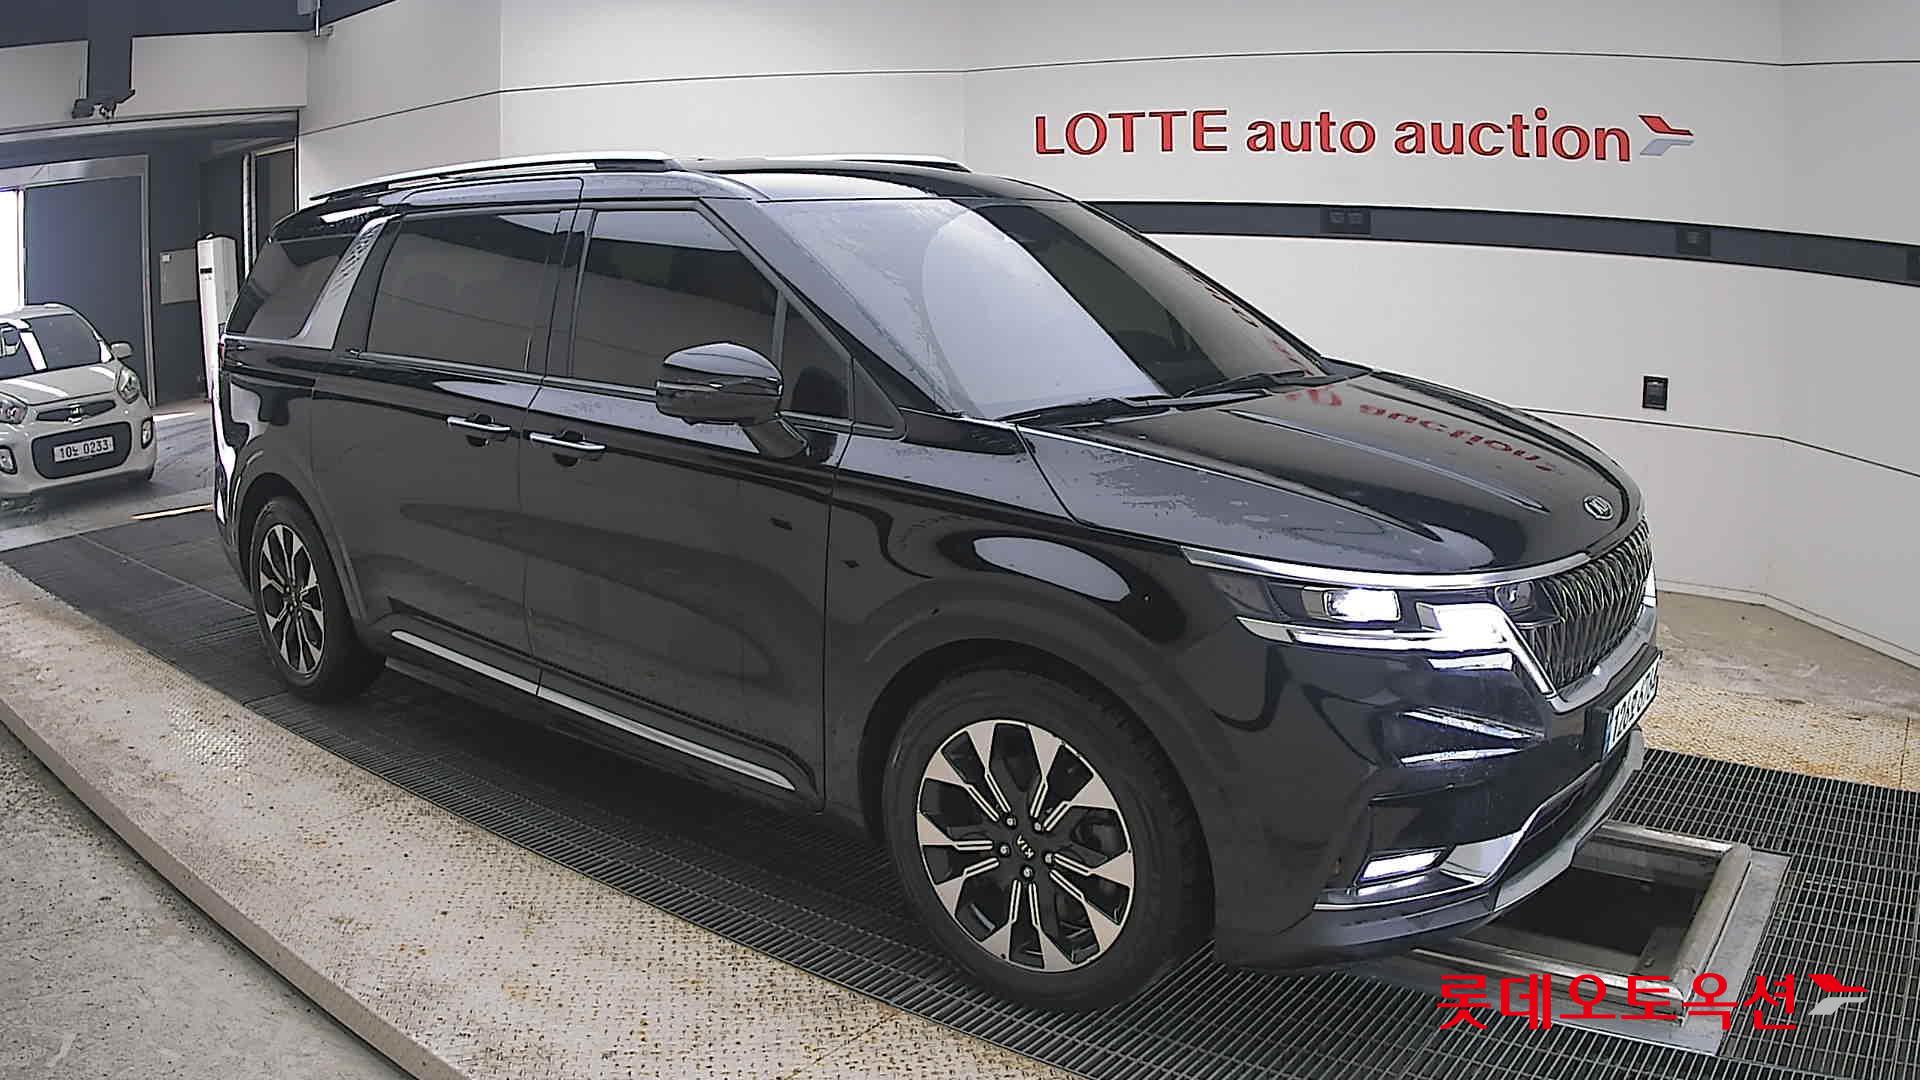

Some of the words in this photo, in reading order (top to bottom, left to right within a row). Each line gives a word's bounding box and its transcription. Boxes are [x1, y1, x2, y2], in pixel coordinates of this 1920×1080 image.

[1036, 109, 1227, 154] LOTTE
[1247, 111, 1376, 154] auto
[1395, 107, 1630, 161] auction
[83, 440, 108, 454] 0233
